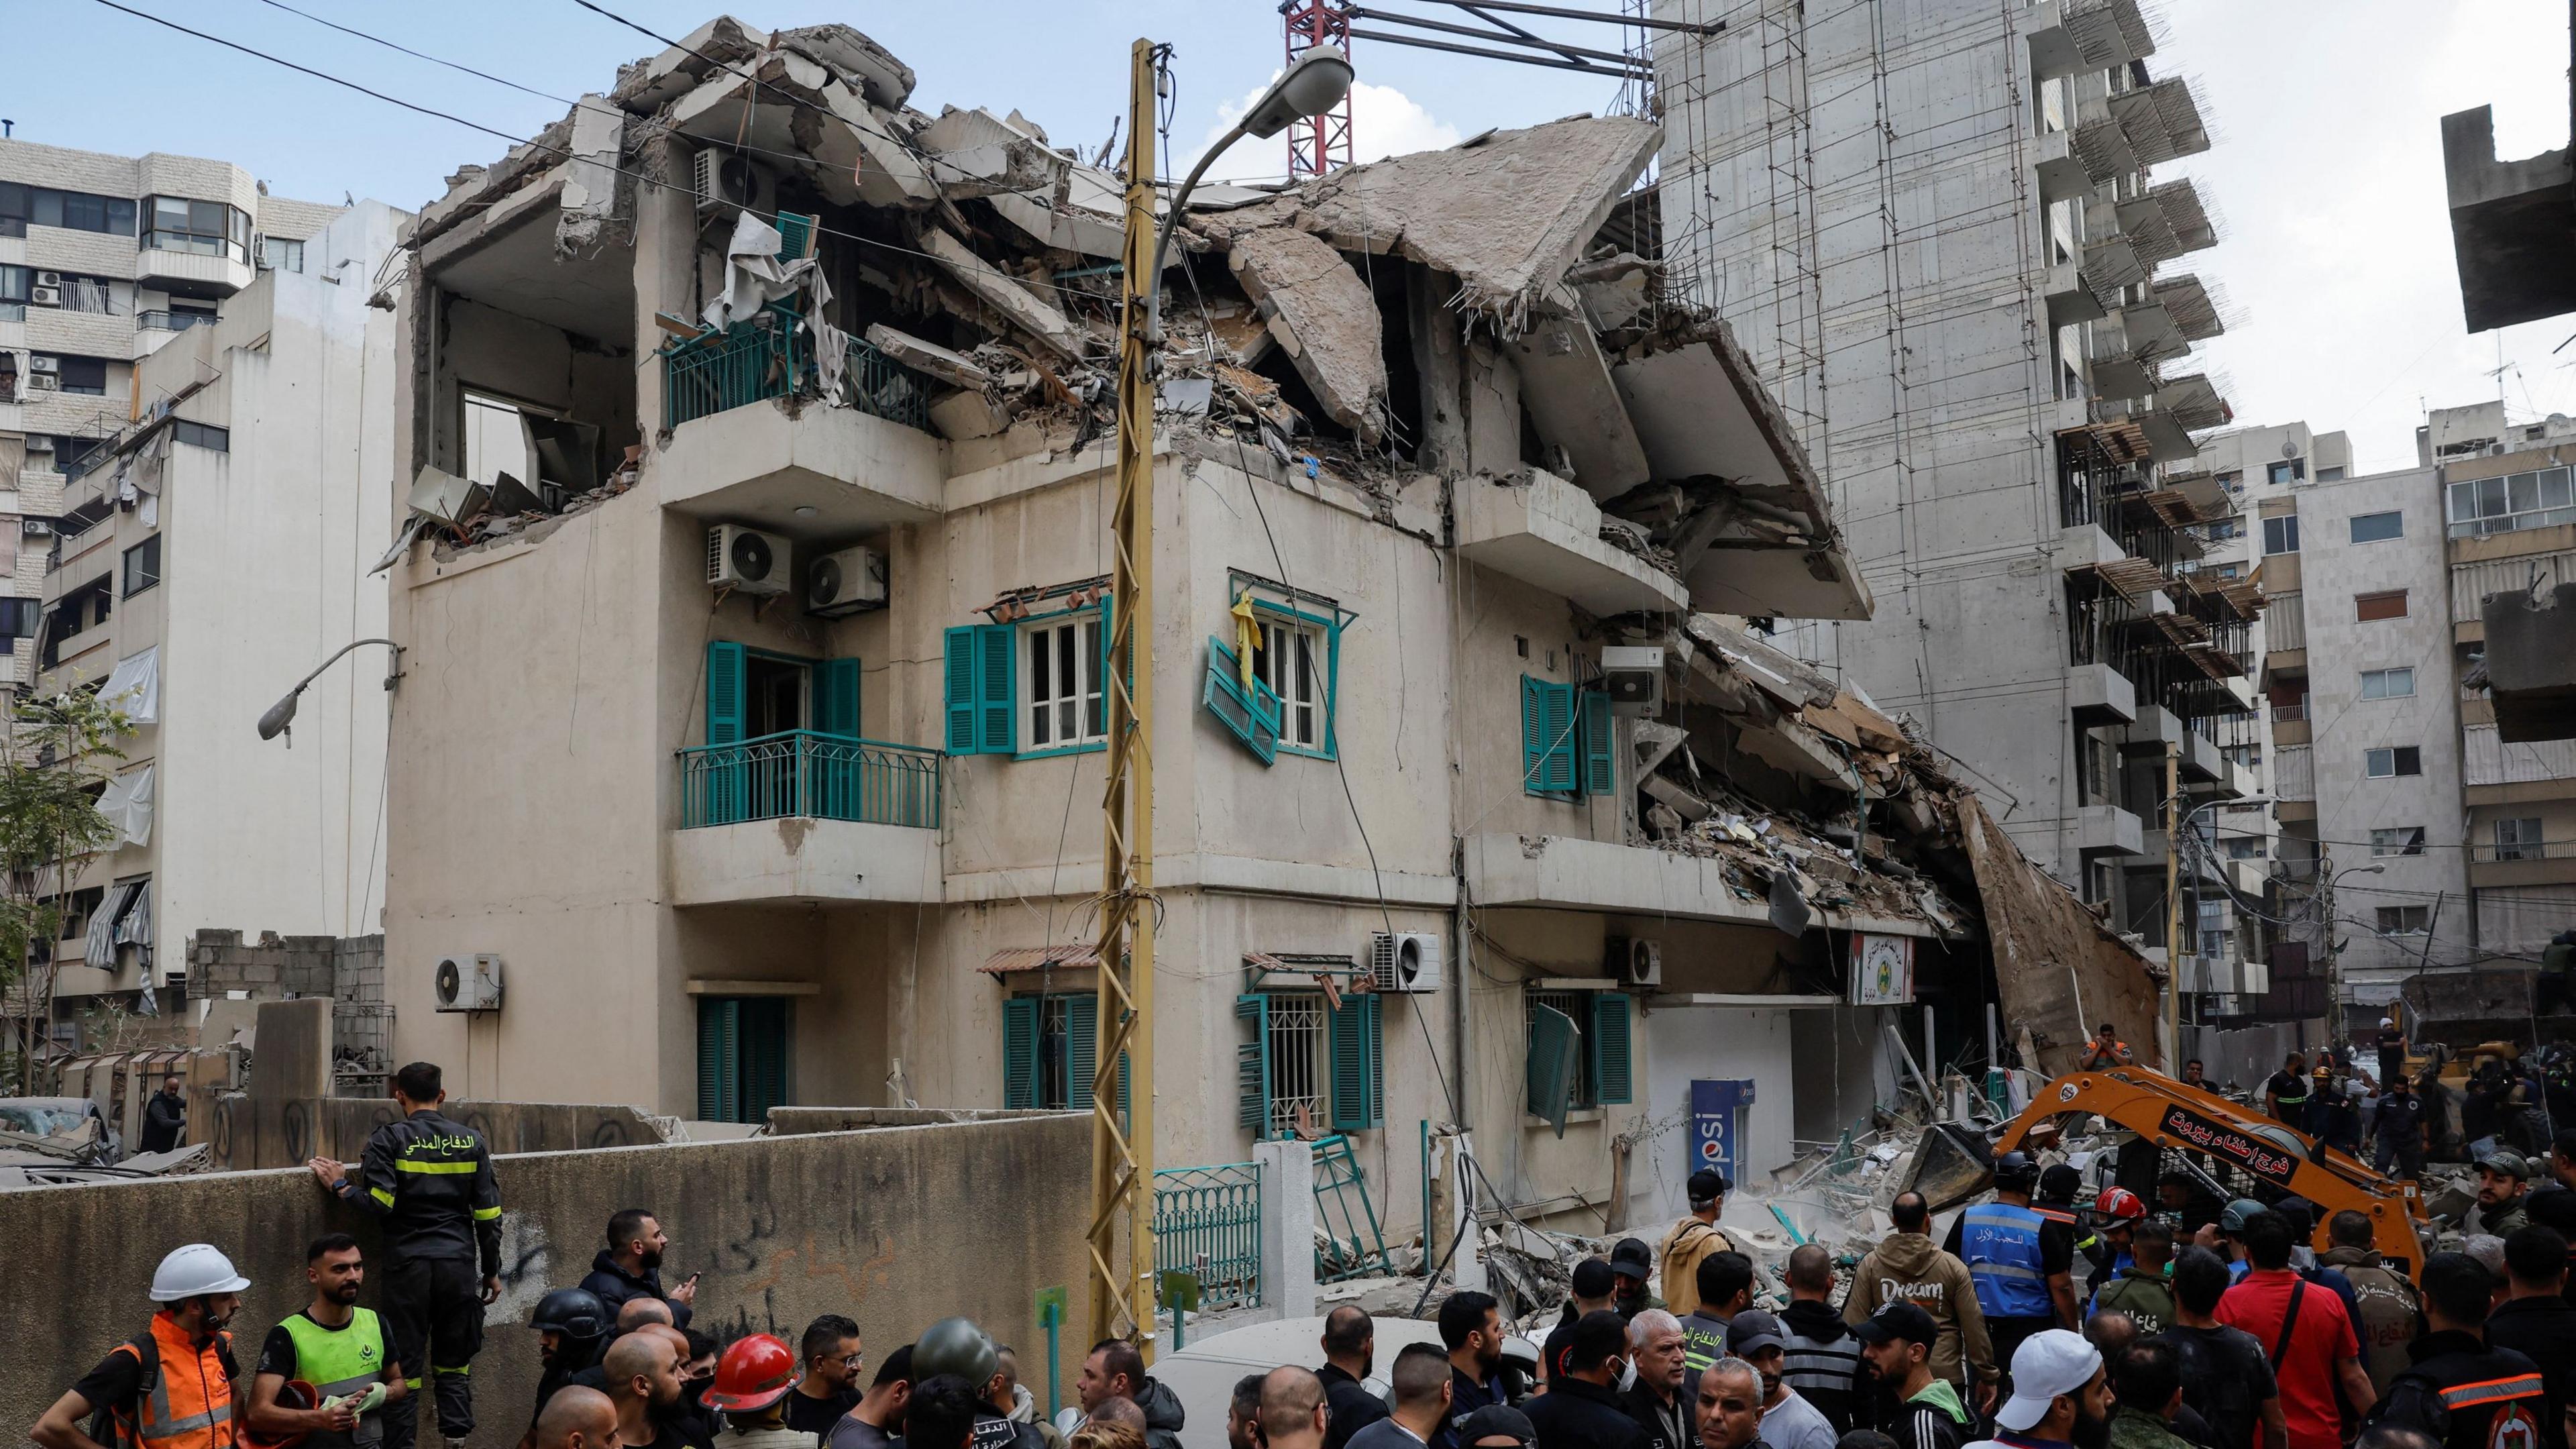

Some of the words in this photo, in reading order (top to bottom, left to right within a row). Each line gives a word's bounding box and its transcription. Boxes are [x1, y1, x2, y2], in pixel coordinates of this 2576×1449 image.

[2169, 1112, 2213, 1145] بيروت
[405, 1134, 440, 1155] المدني
[441, 1134, 474, 1156] الدفاع
[2212, 1134, 2259, 1165] إطفاء
[2255, 1153, 2289, 1175] فوج
[1976, 1228, 1992, 1243] الأول
[2369, 1283, 2395, 1298] شبيبة
[2396, 1290, 2417, 1315] جمعية
[1691, 1330, 1722, 1348] الدفاع
[975, 1422, 1007, 1435] الدفا
